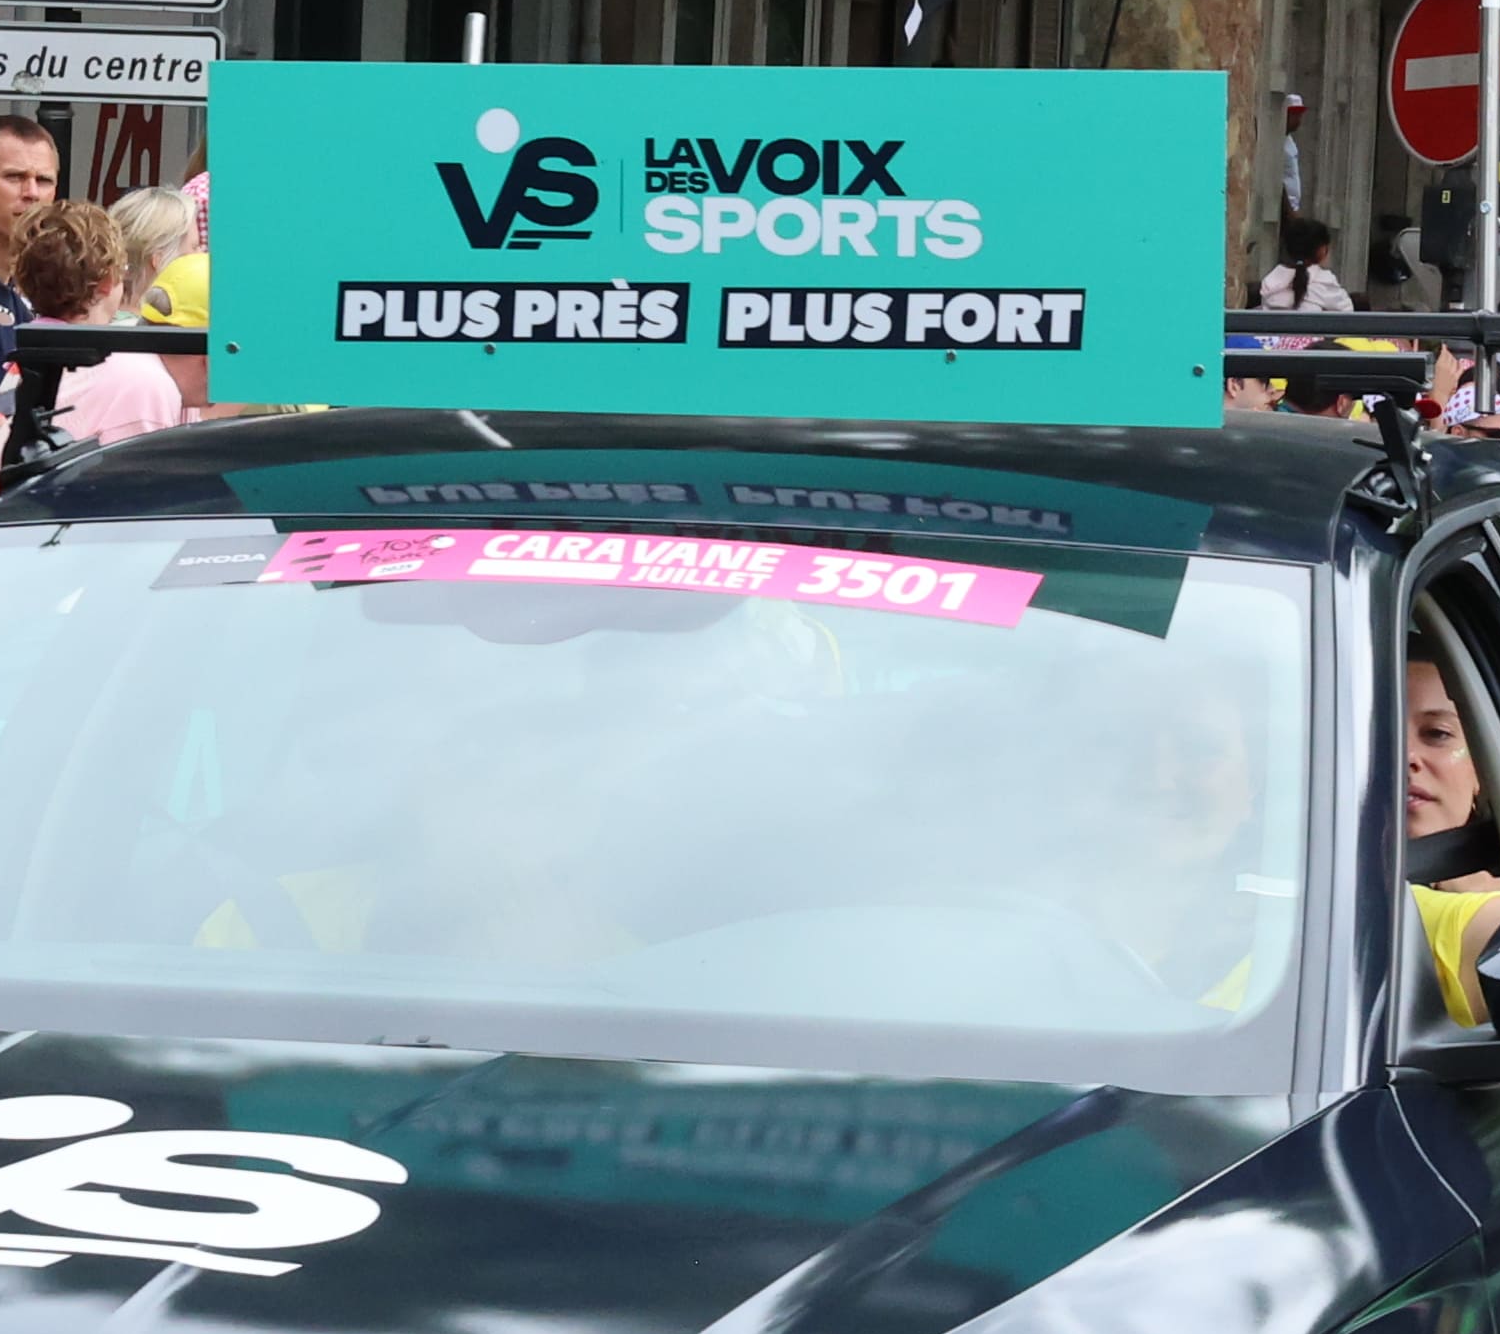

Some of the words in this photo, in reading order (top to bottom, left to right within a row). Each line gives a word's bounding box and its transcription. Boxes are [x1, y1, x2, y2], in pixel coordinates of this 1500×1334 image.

[25, 45, 67, 79] du
[83, 53, 204, 84] centre
[644, 137, 702, 168] LA
[697, 139, 906, 196] VOIX
[644, 170, 709, 194] DES
[643, 195, 983, 260] SPORTS
[341, 289, 500, 339] PLUS
[513, 277, 680, 340] PRÈS
[726, 293, 894, 344] PLUS
[905, 293, 1083, 346] FORT
[482, 534, 788, 575] CARAVANE
[627, 564, 774, 591] JUILLET
[796, 555, 977, 611] 3501
